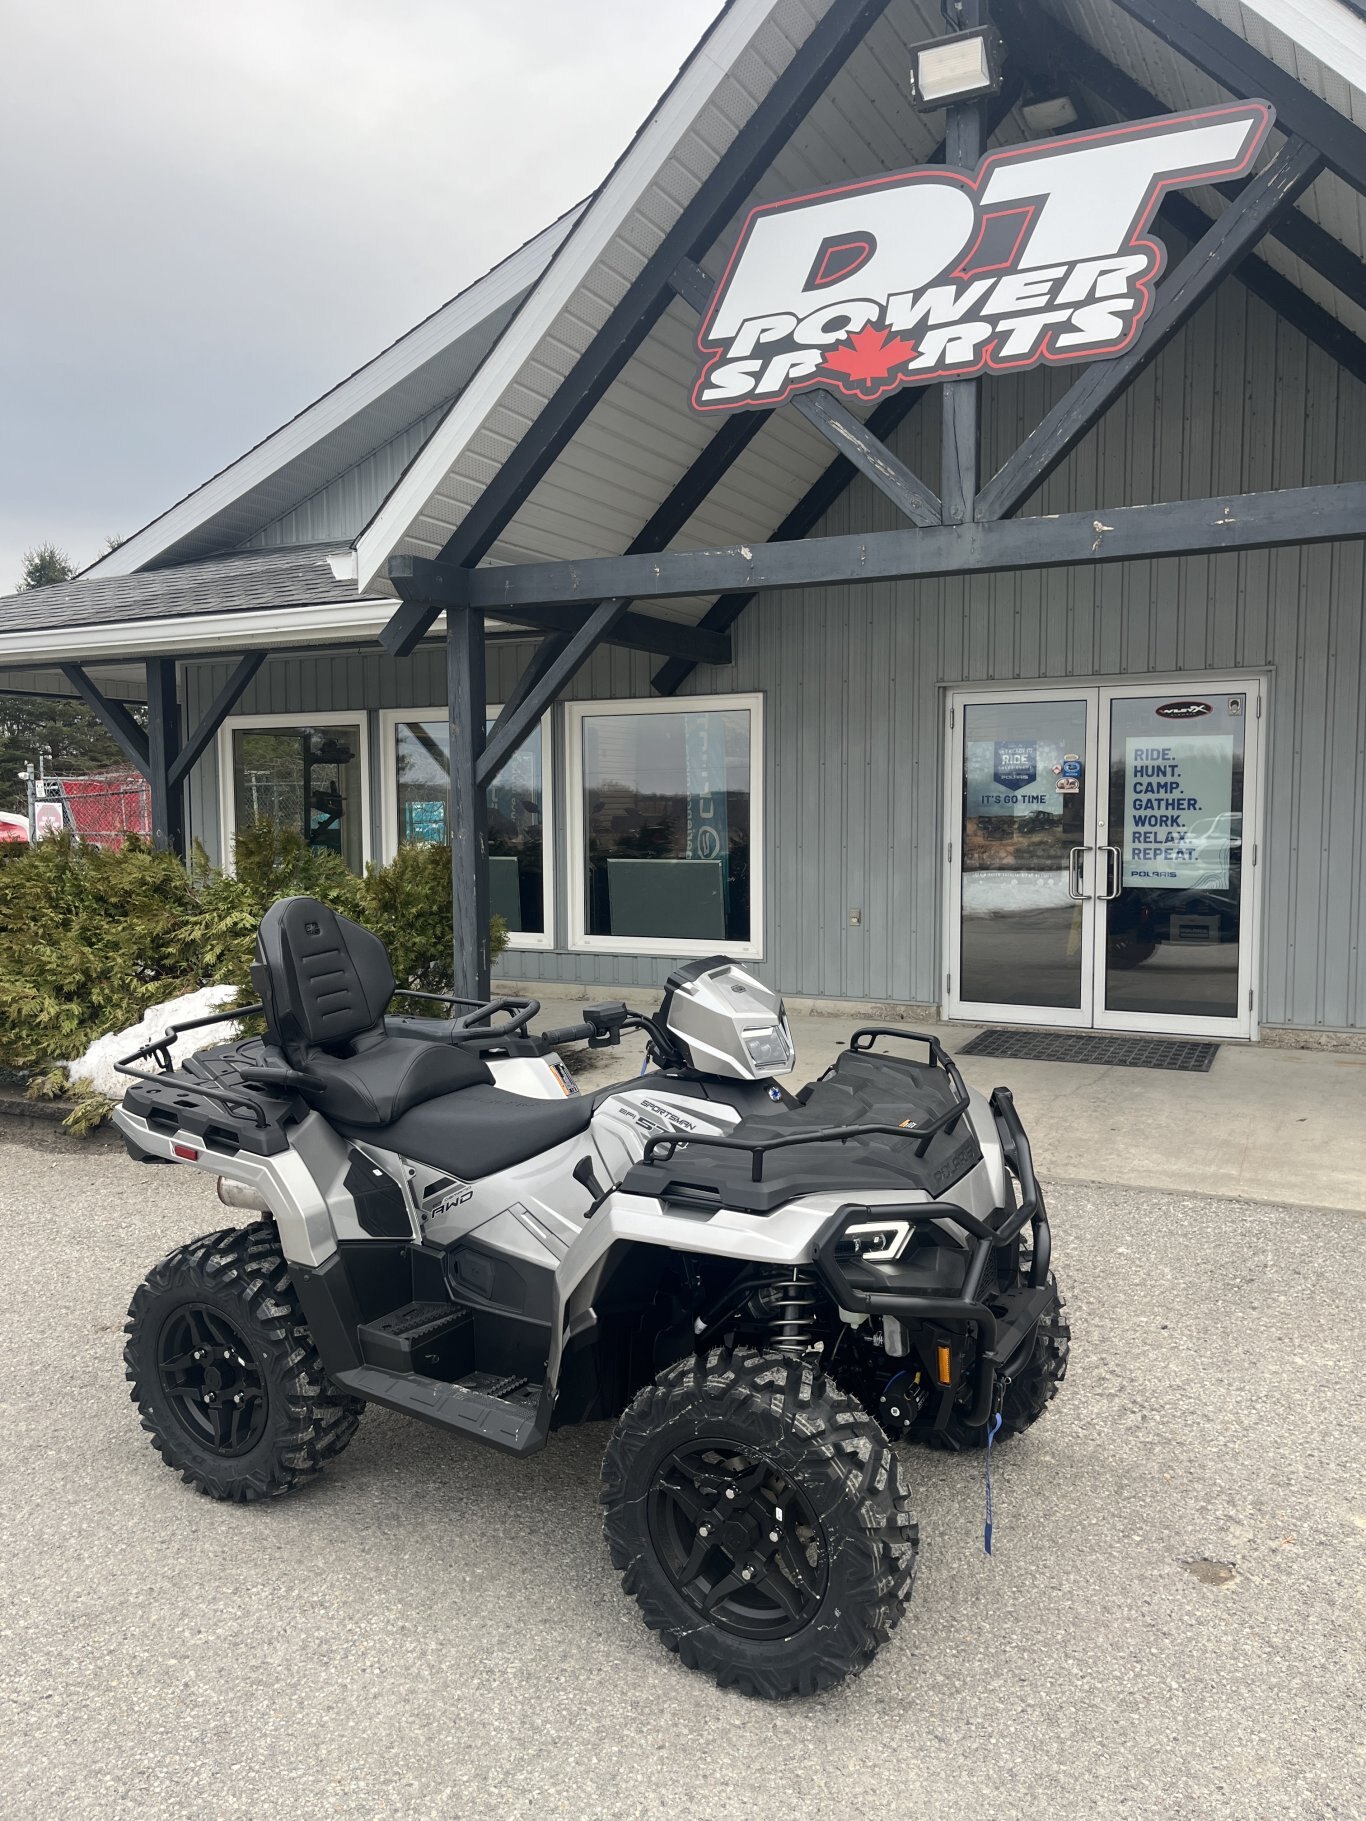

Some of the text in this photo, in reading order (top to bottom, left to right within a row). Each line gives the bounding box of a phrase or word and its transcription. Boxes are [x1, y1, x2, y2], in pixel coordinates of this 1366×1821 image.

[708, 118, 1255, 342] DT
[726, 254, 1149, 359] POWER
[702, 298, 1135, 401] SPRTS
[1001, 754, 1029, 765] RIDE
[1134, 748, 1176, 761] RIDE.
[1133, 764, 1181, 778] HUNT.
[1133, 781, 1184, 795] CAMP.
[981, 794, 1047, 804] IT'S GO TIME
[1132, 797, 1202, 811] GATHER.
[1132, 814, 1186, 828] WORK.
[1132, 831, 1192, 844] RELAX.
[1131, 847, 1199, 861] REPEAT.
[640, 1100, 697, 1131] SPORTSMAN
[431, 1190, 474, 1219] AWD
